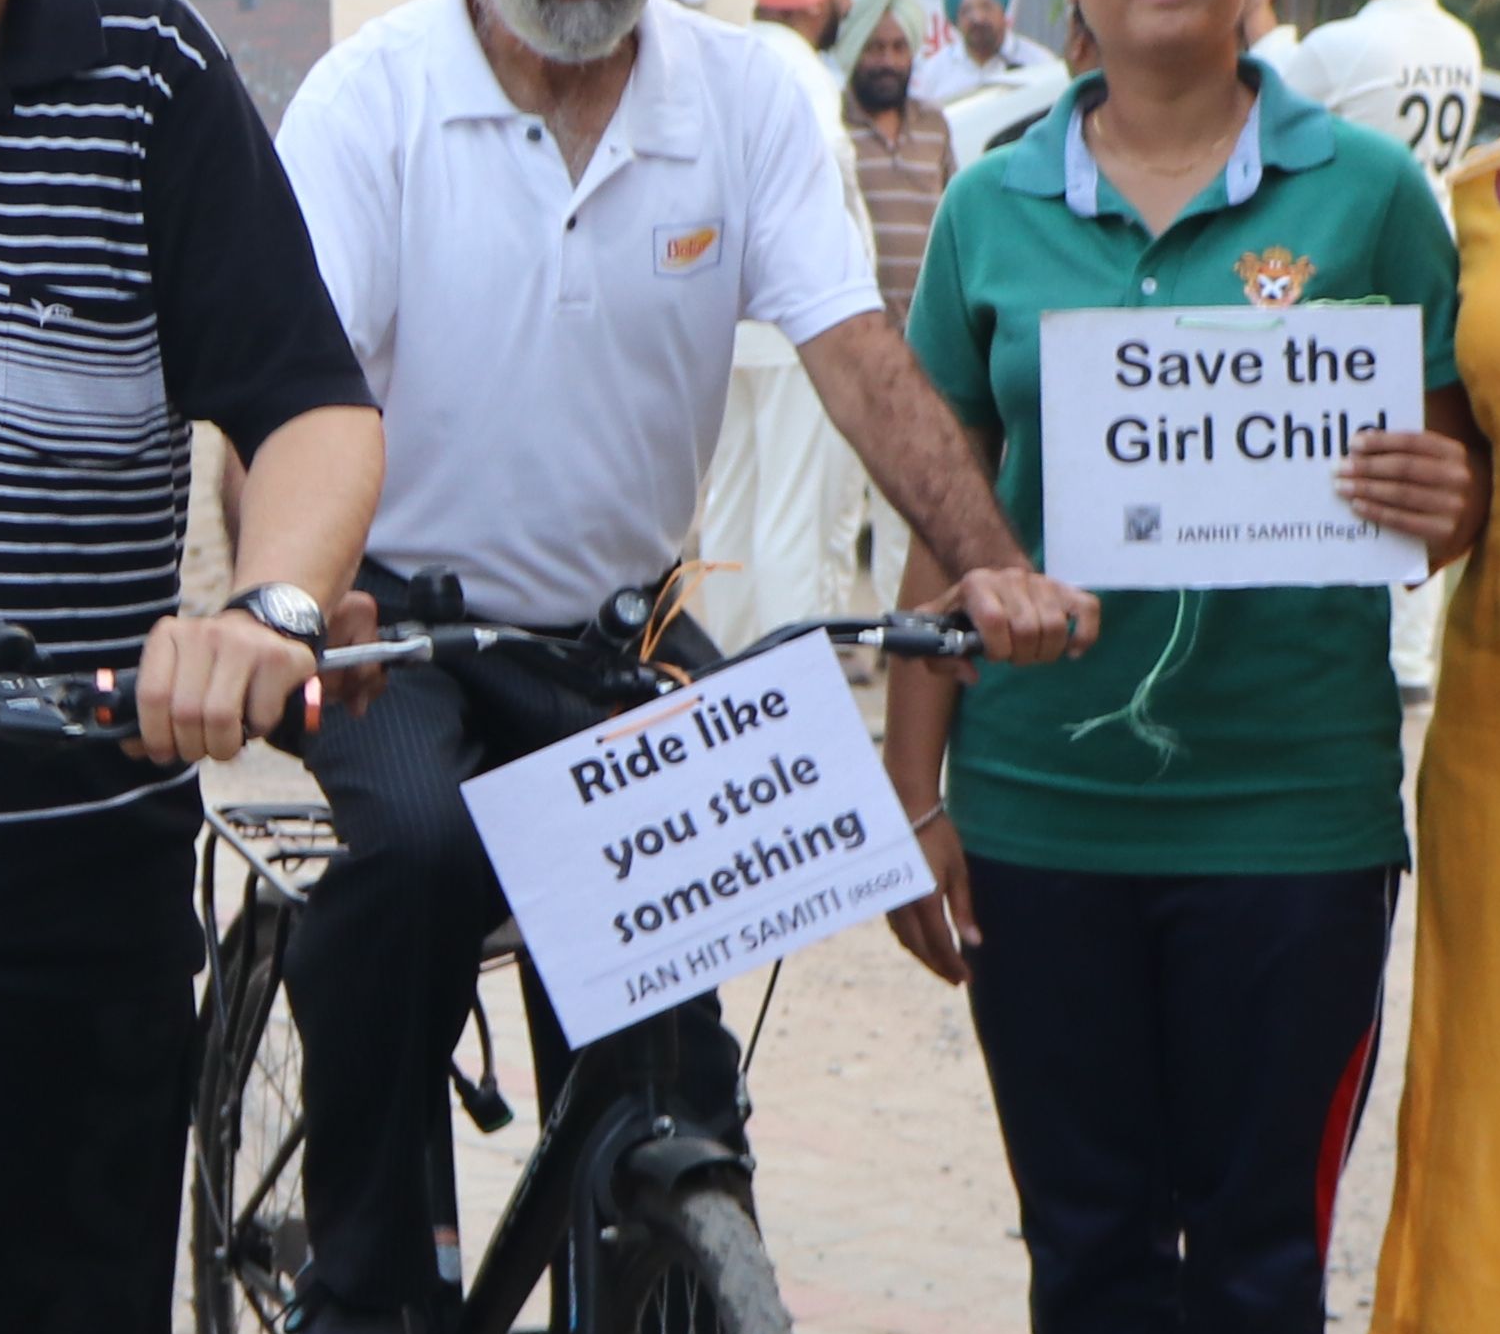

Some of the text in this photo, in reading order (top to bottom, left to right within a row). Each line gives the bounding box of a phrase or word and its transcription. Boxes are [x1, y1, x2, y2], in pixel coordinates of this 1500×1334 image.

[1397, 66, 1473, 88] JATIN
[1399, 92, 1466, 175] 29
[1114, 335, 1376, 388] Save the
[1106, 413, 1214, 464] Girl
[1176, 524, 1241, 544] JANHIT
[1247, 522, 1312, 541] SAMITI
[569, 686, 790, 805] Ride like
[602, 753, 821, 880] you stole
[612, 808, 868, 944] something
[623, 959, 683, 1005] JAN
[686, 935, 732, 979] HIT
[740, 887, 845, 952] SAMITI
